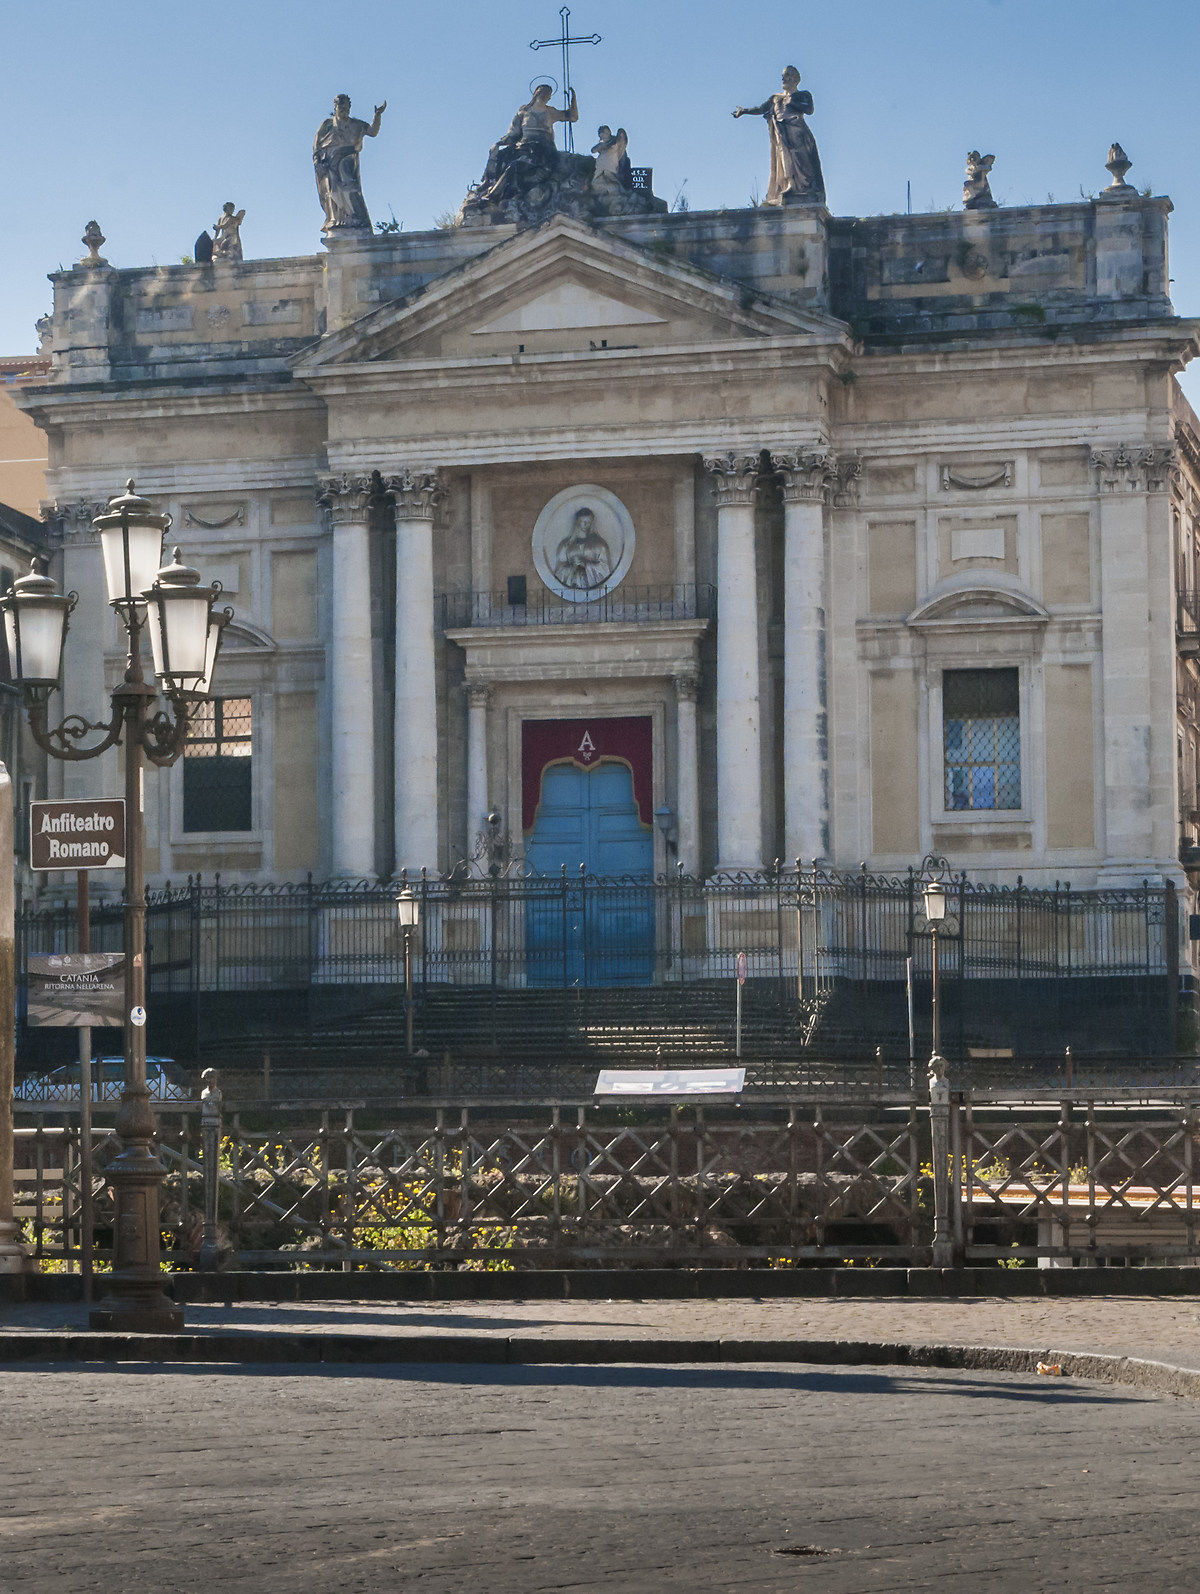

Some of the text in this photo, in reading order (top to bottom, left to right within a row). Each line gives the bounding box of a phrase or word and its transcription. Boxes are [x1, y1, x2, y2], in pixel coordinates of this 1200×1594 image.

[578, 731, 595, 750] A
[40, 812, 115, 833] Anfiteatro
[49, 839, 109, 858] Romano
[60, 974, 99, 982] CATANIA
